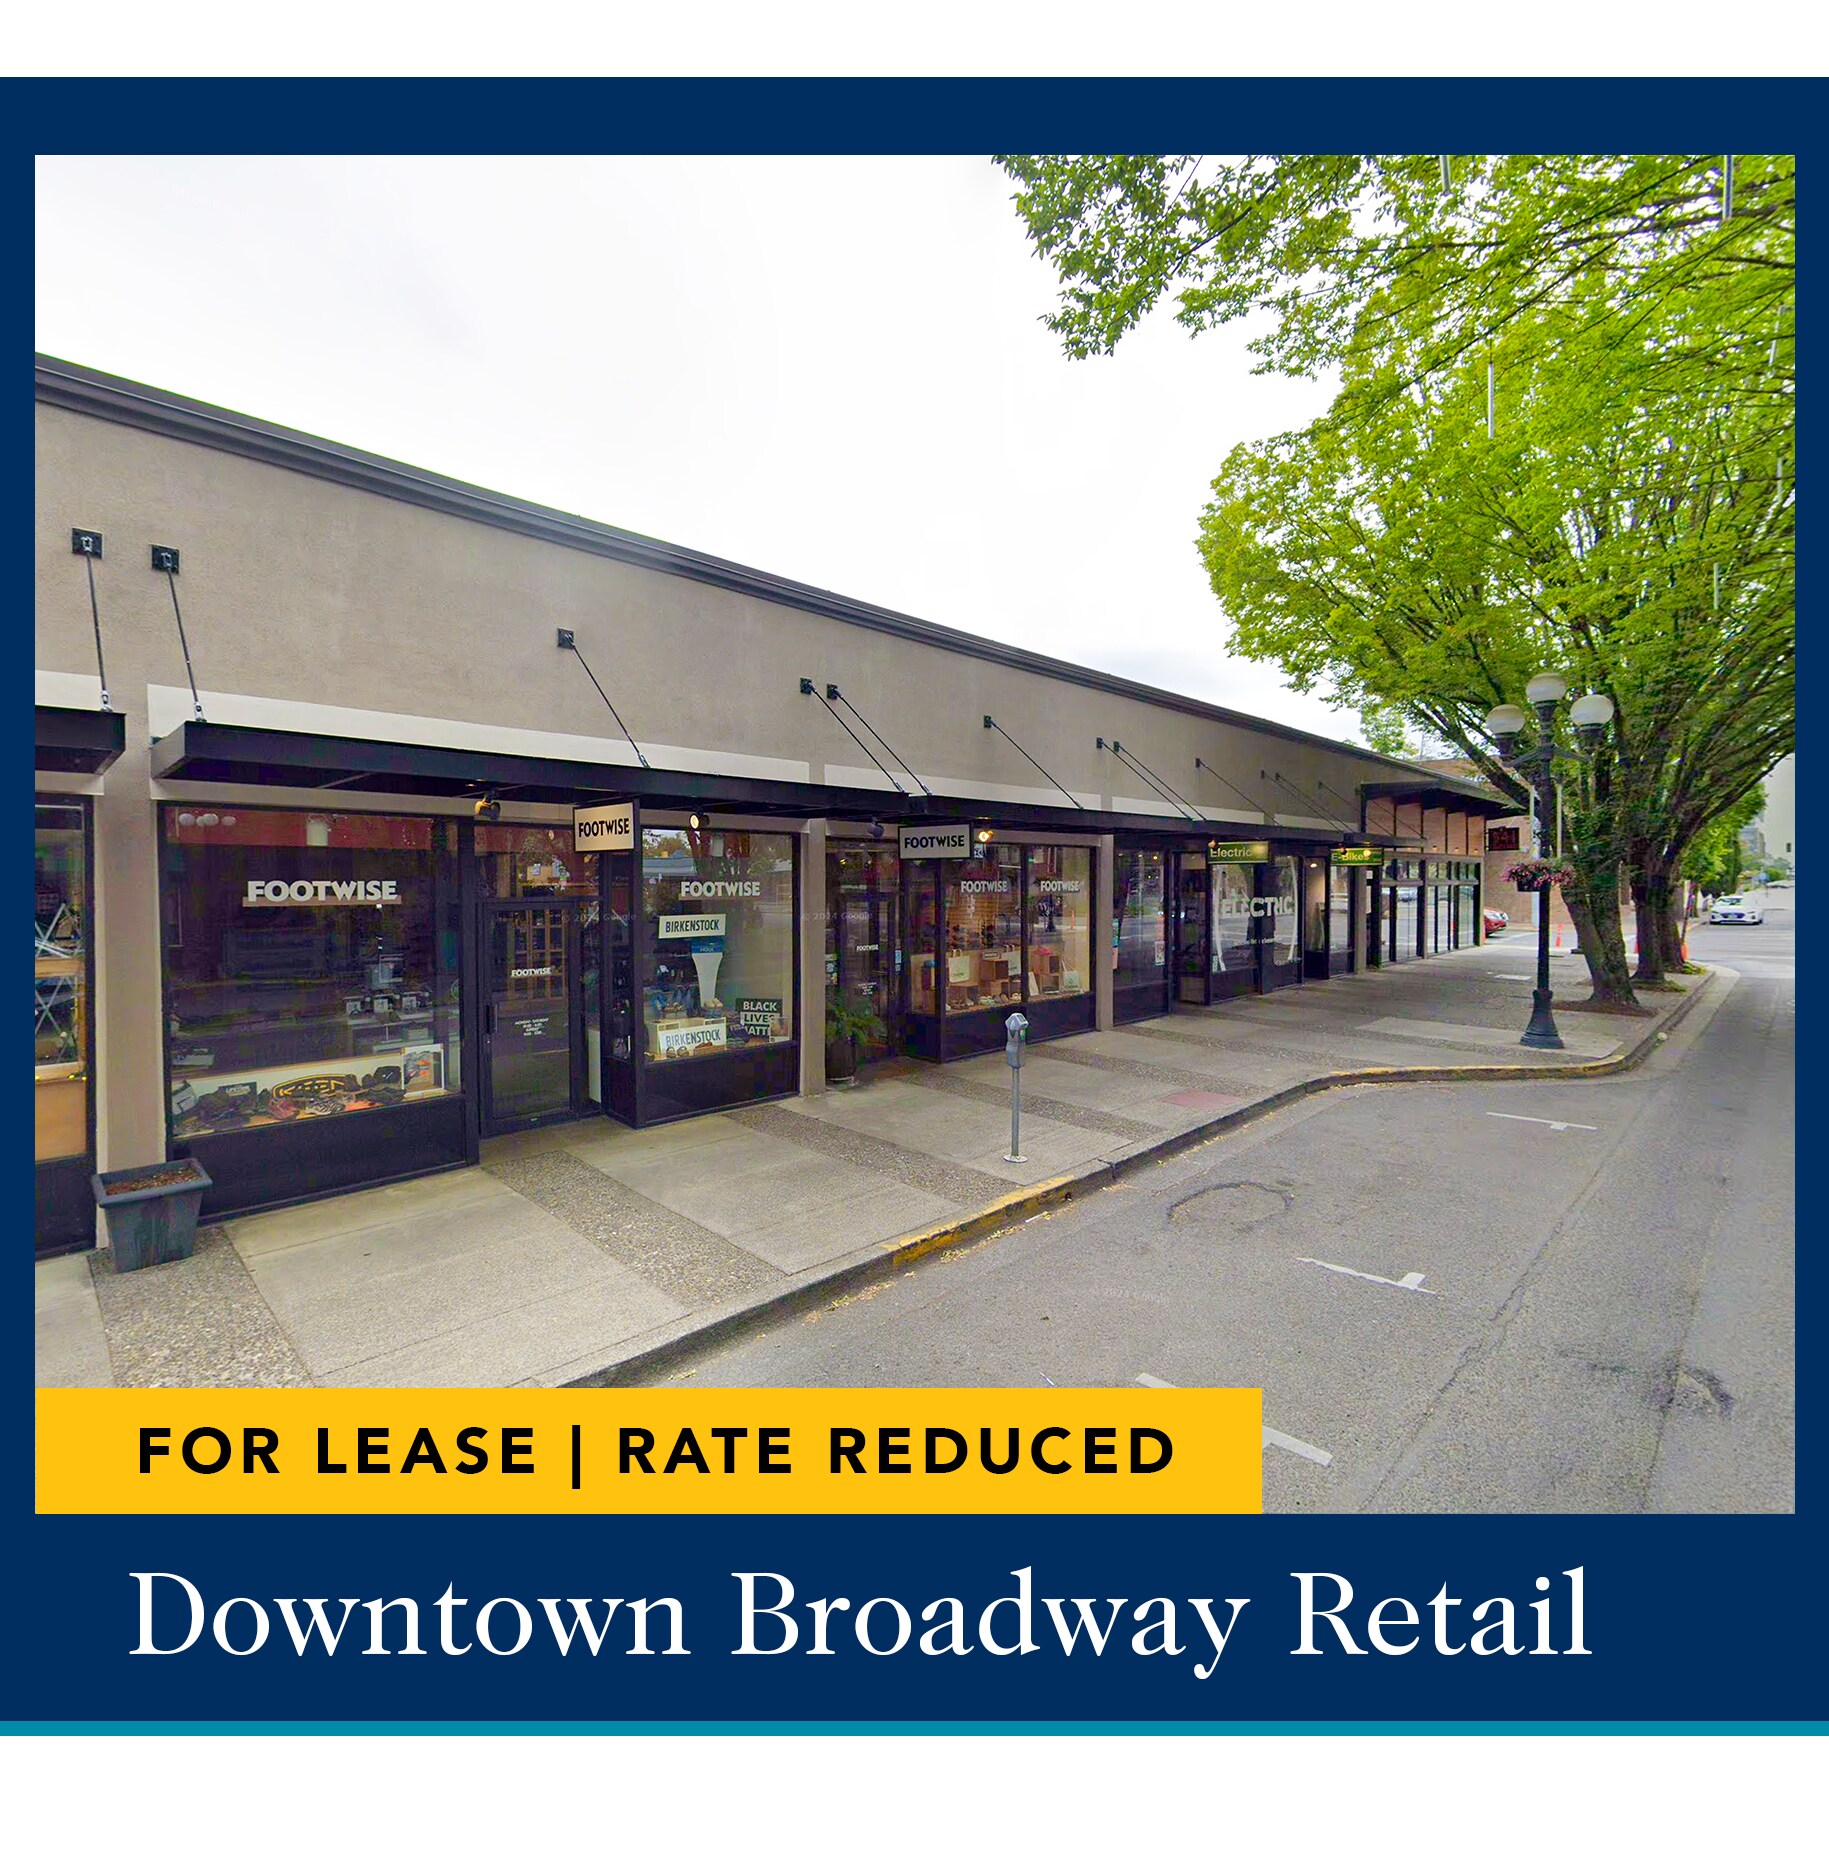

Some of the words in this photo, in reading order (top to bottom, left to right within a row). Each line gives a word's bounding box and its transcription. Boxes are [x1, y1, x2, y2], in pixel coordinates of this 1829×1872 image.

[578, 817, 630, 838] FOOTWISE
[904, 834, 965, 849] FOOTWISE
[1210, 847, 1253, 858] Electric
[247, 879, 397, 902] FOOTWISE
[680, 881, 761, 897] FOOTWISE
[960, 880, 1008, 893] FOOTWISE
[1040, 880, 1080, 892] FOOTWISE
[665, 918, 720, 933] BIRKENSTOCK
[856, 944, 879, 952] FOOTWISE
[511, 967, 552, 977] FOOTWISE
[743, 1001, 778, 1012] BLACK
[665, 1029, 721, 1047] BIRKENSTOCK
